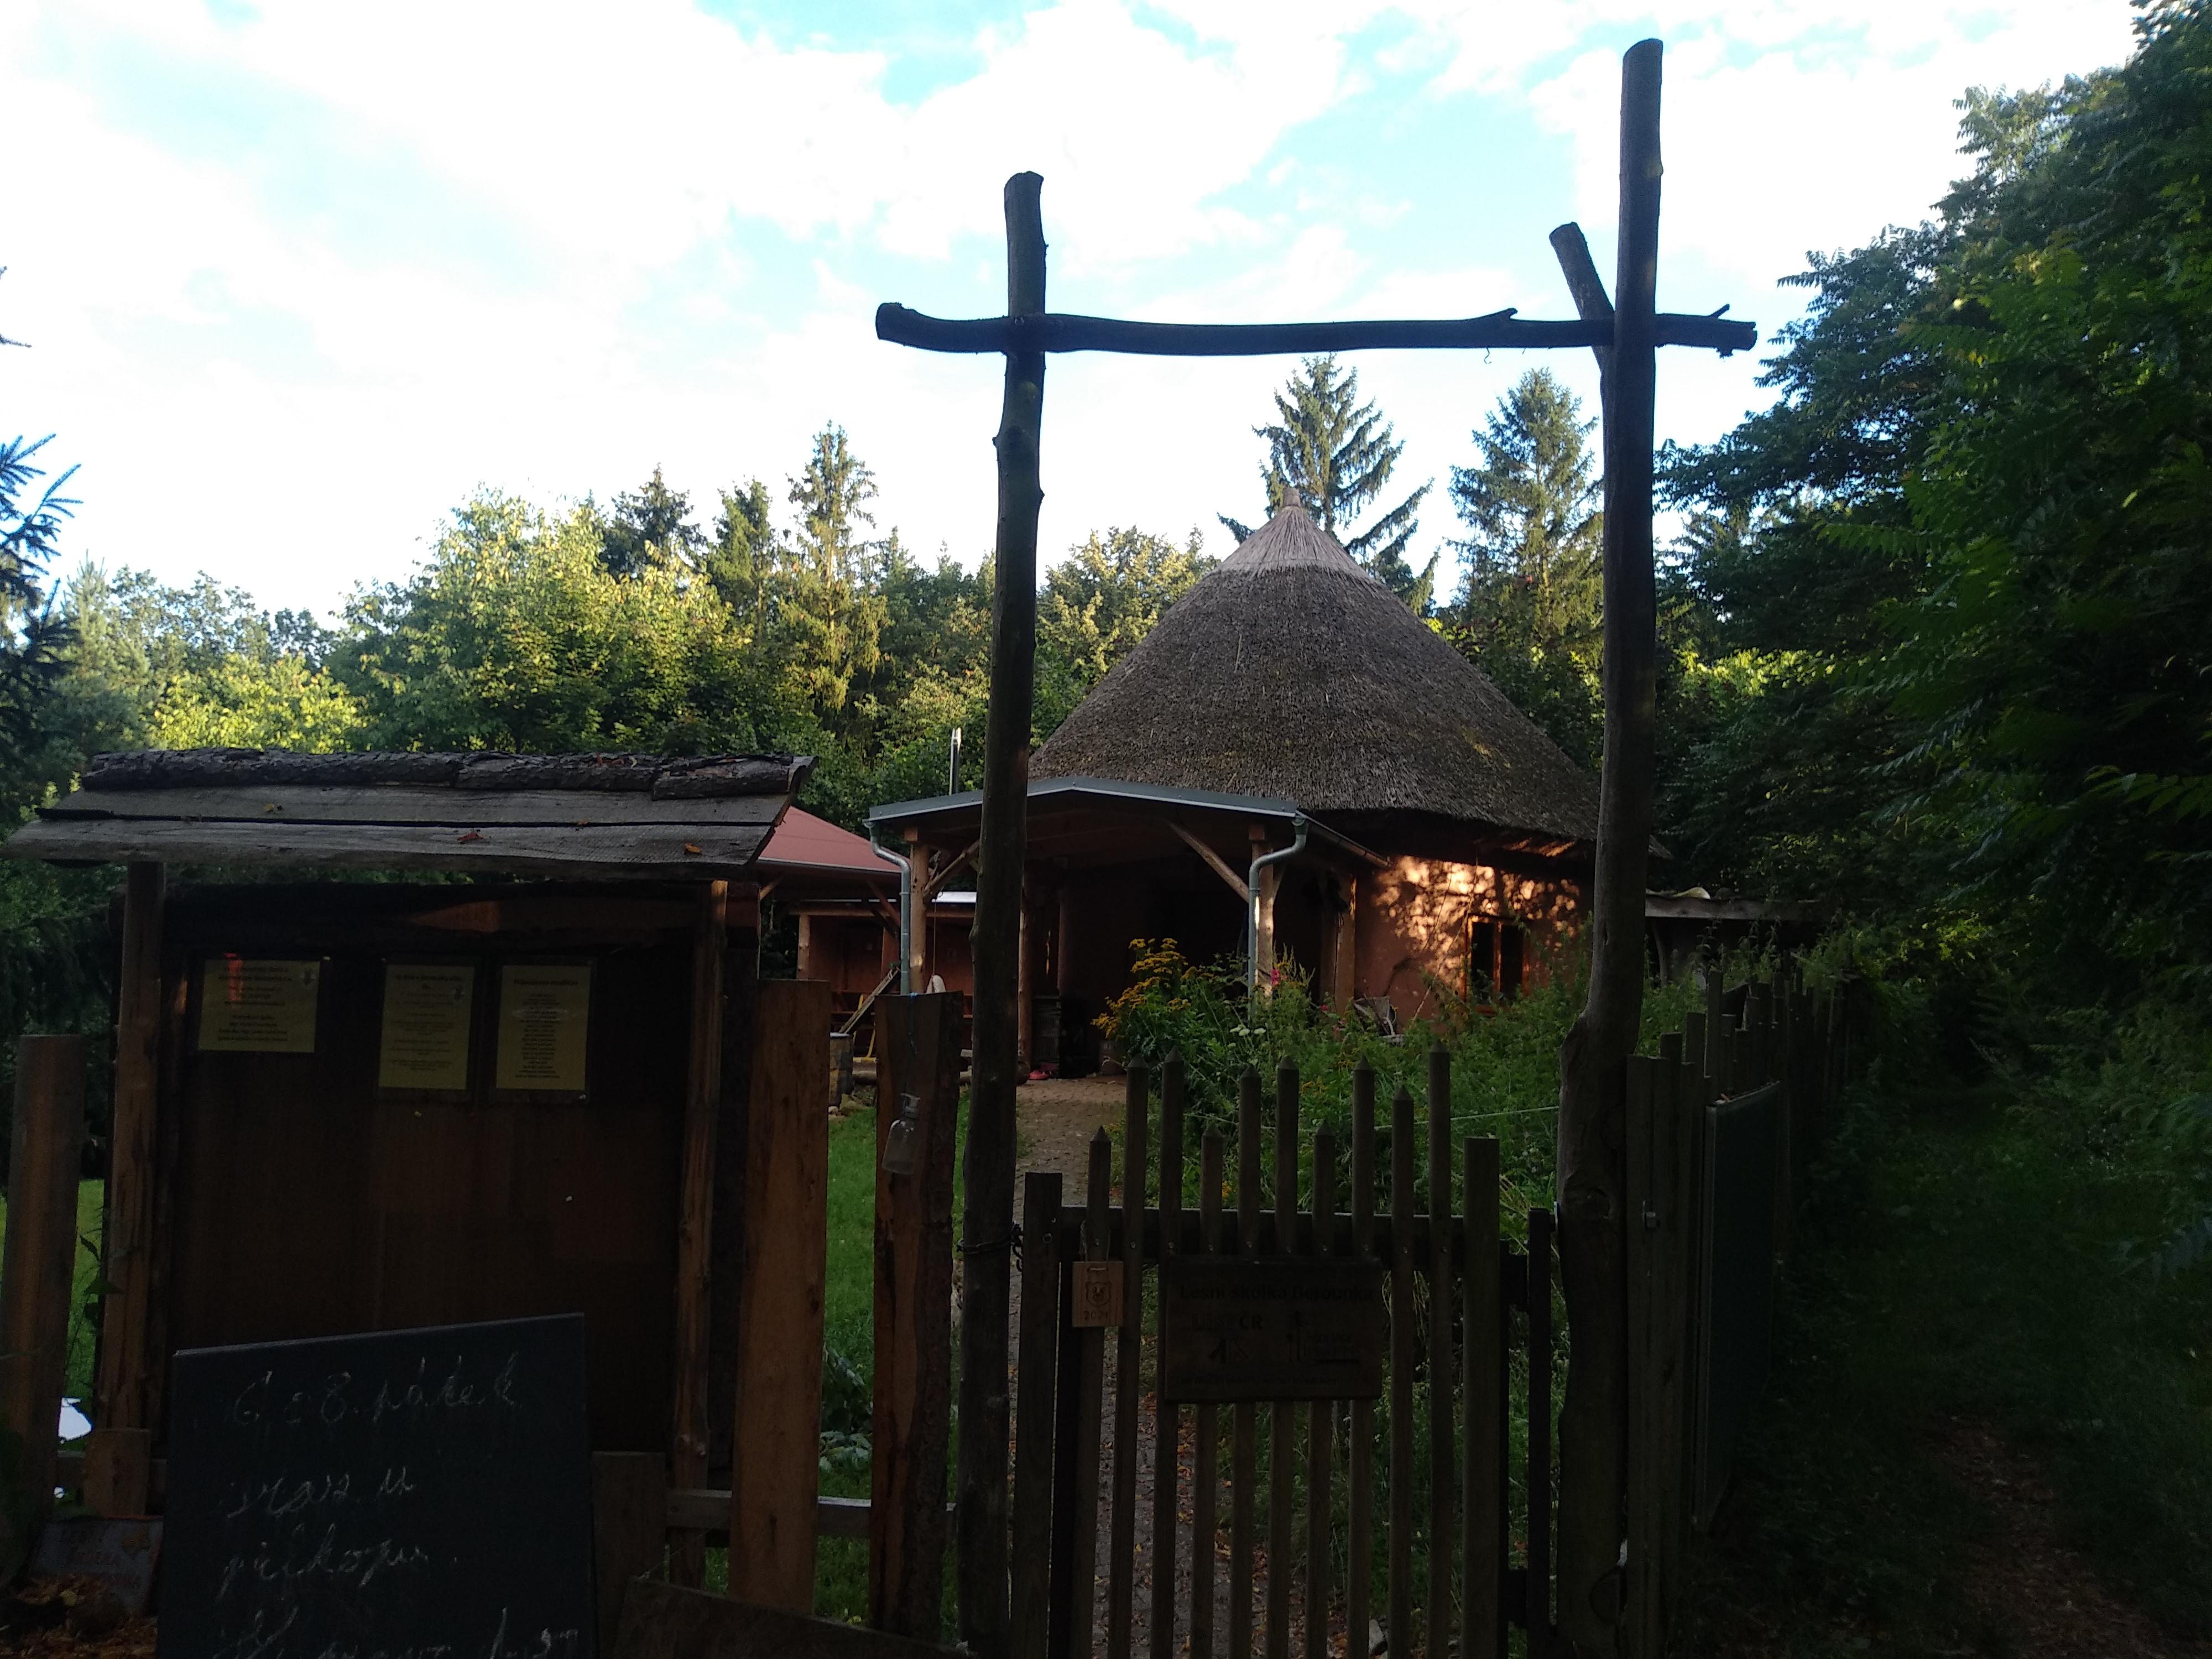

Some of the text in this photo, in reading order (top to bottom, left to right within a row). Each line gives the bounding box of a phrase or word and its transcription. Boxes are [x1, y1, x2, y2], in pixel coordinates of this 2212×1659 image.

[1292, 1284, 1373, 1301] Berounka
[1083, 1310, 1109, 1320] 2021
[1239, 1310, 1263, 1331] ČR
